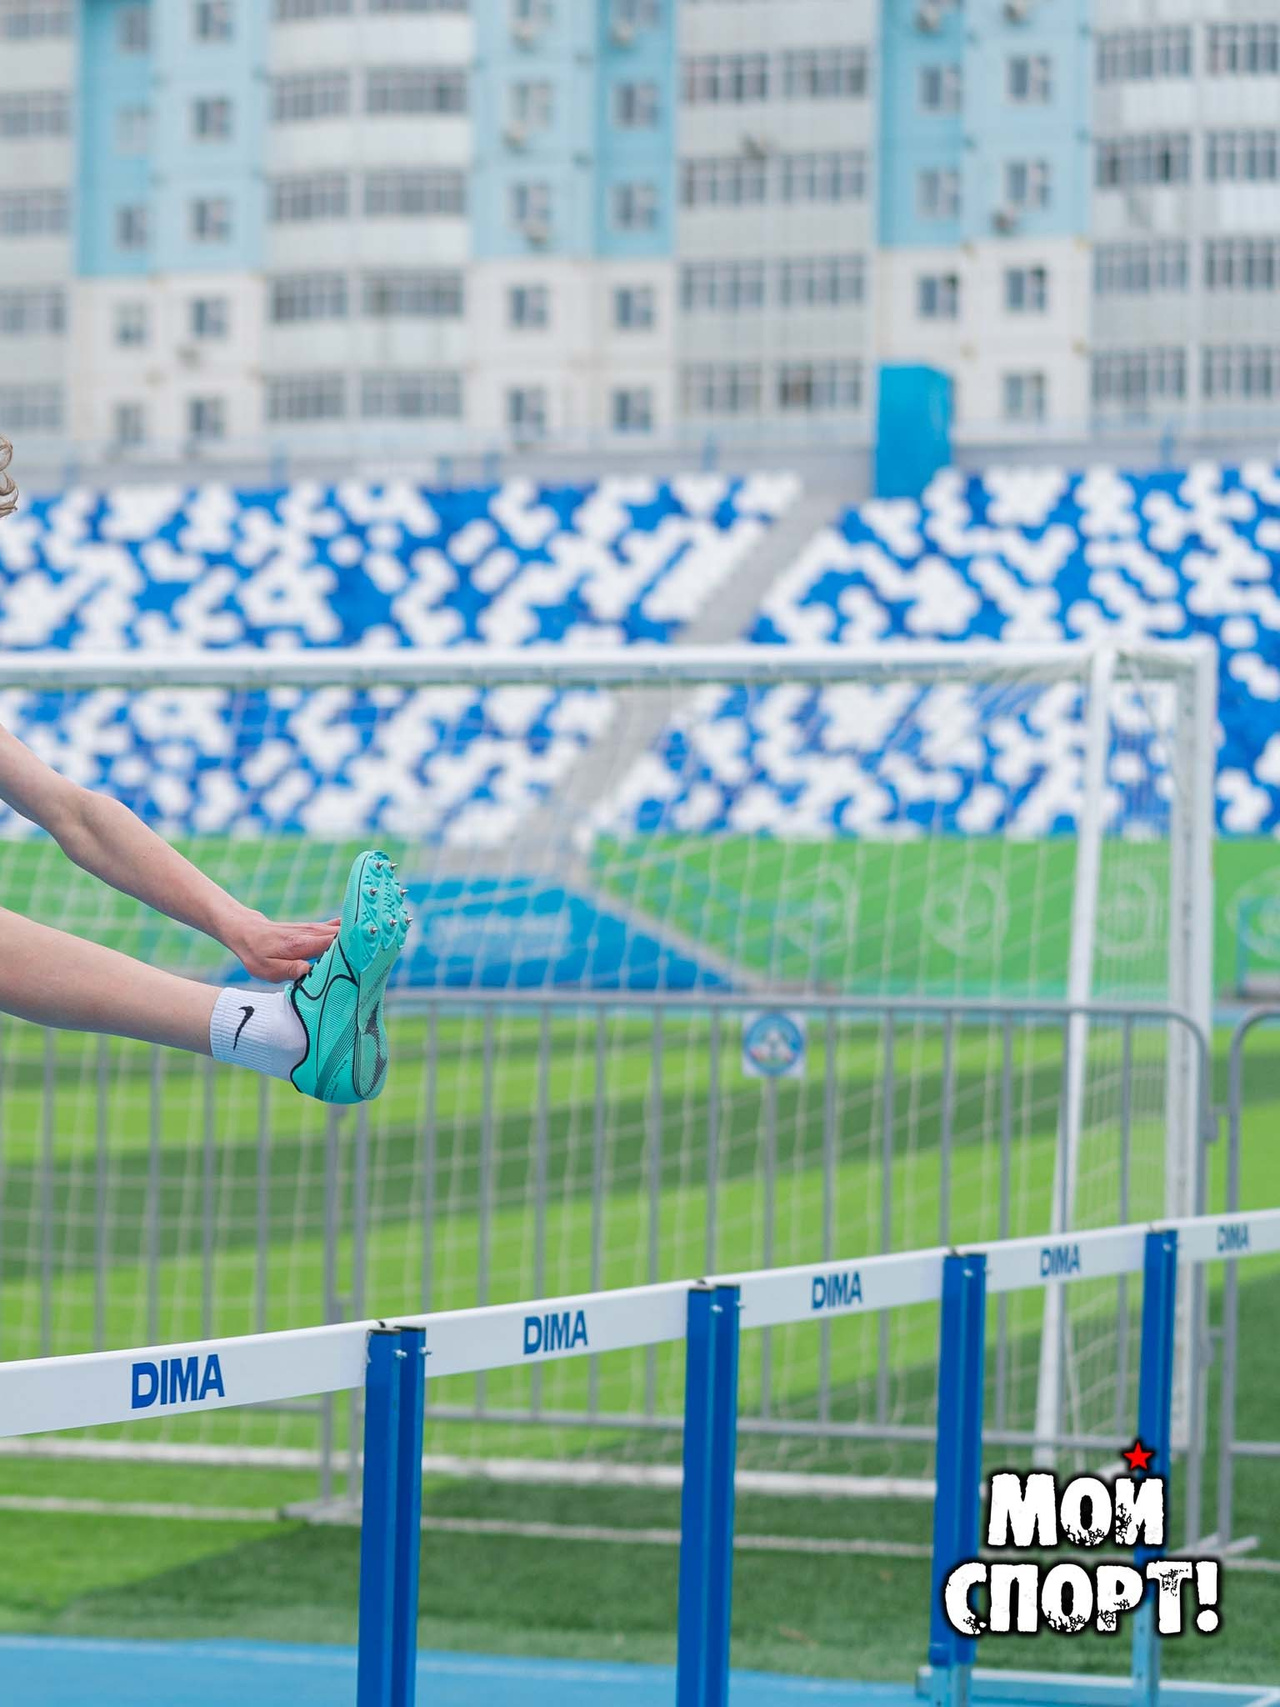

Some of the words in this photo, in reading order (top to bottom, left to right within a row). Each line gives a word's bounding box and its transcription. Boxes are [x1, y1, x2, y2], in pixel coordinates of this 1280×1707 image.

[1216, 1223, 1250, 1254] DIMA
[1039, 1243, 1081, 1279] DIMA
[810, 1270, 864, 1311] DIMA
[522, 1309, 589, 1356] DIMA
[130, 1353, 226, 1410] DIMA
